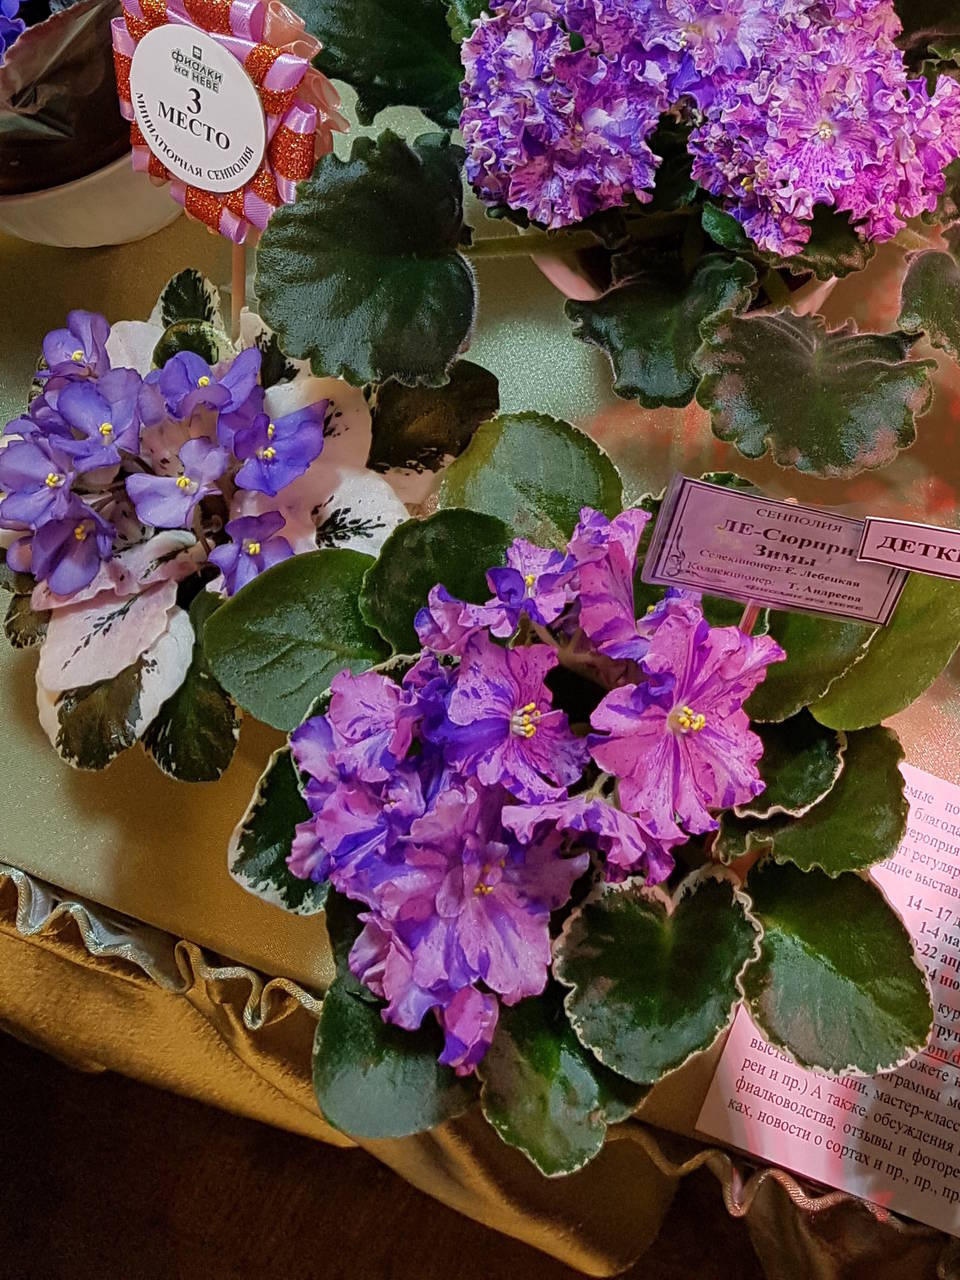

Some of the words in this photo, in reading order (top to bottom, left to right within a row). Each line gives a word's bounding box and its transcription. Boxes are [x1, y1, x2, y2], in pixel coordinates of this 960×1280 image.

[185, 86, 204, 116] 3
[134, 91, 204, 179] МИНИАТЮРНАЯ
[206, 145, 256, 182] СЕНПОЛИЯ
[156, 99, 231, 151] МЕСТО
[755, 507, 844, 534] СЕНПОЛИЯ
[698, 548, 784, 574] Селекционер:
[752, 543, 818, 569] Зимы
[803, 584, 862, 604] Андреева
[905, 894, 923, 912] 14
[935, 906, 953, 923] 17
[919, 921, 941, 940] 1-4
[909, 1058, 950, 1083] ожете
[734, 1074, 837, 1131] фиалководства,
[842, 1121, 894, 1152] отзывы
[897, 1144, 908, 1158] и
[769, 1069, 779, 1082] и
[780, 1073, 810, 1095] пр.)
[810, 1085, 824, 1101] А
[826, 1092, 870, 1120] также,
[872, 1111, 956, 1153] обсуждения
[727, 1097, 754, 1119] ках,
[756, 1109, 812, 1142] новости
[813, 1134, 824, 1147] о
[824, 1139, 872, 1166] сортах
[872, 1157, 884, 1171] и
[884, 1160, 910, 1184] пр.,
[912, 1172, 938, 1195] пр.,
